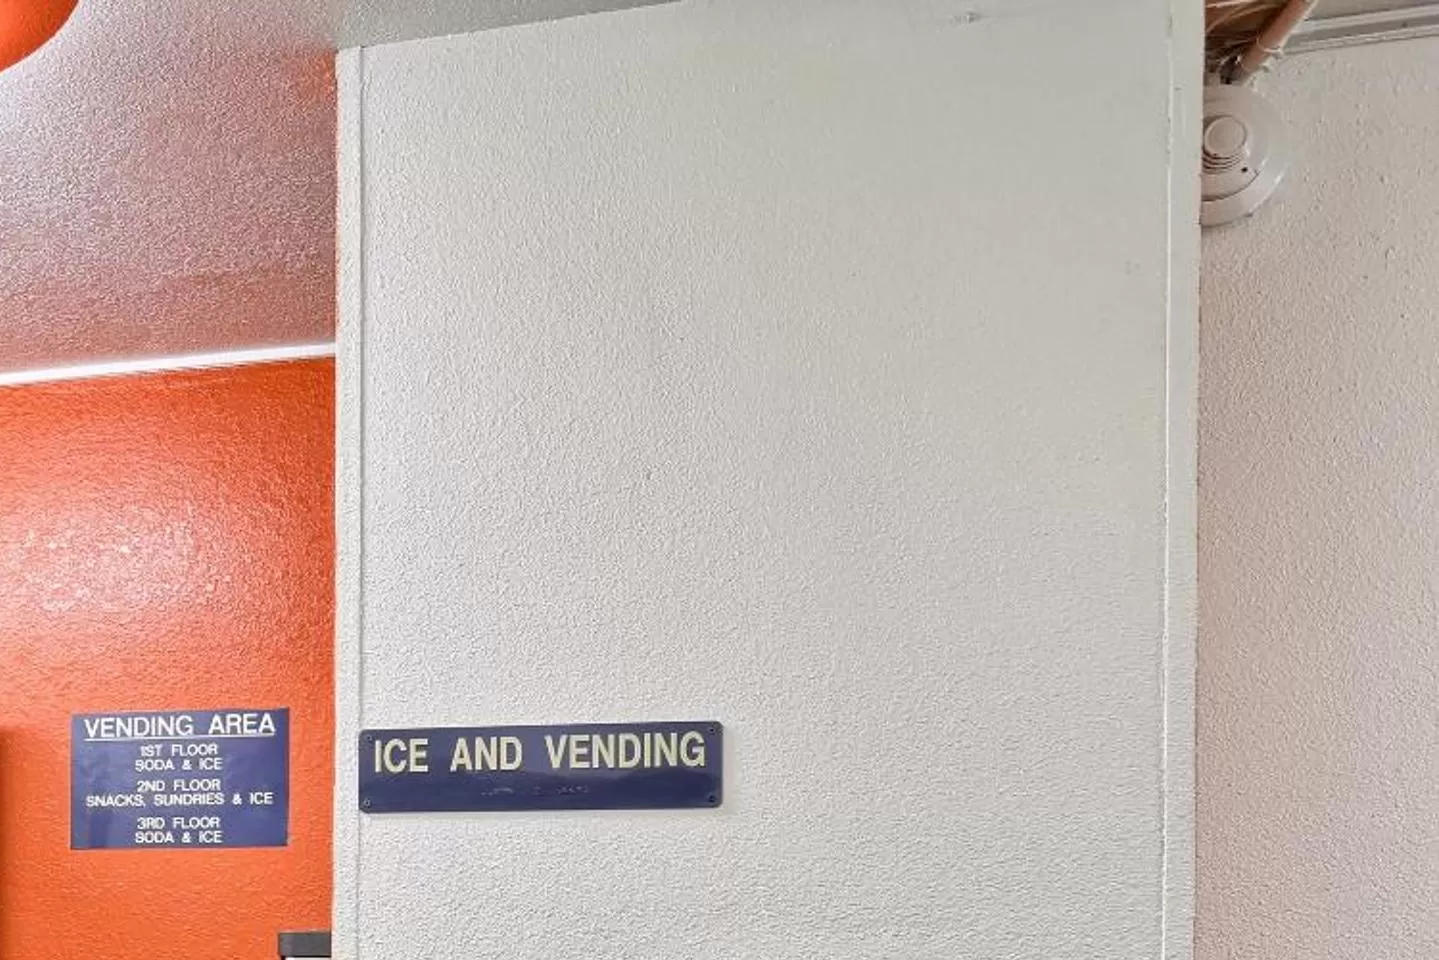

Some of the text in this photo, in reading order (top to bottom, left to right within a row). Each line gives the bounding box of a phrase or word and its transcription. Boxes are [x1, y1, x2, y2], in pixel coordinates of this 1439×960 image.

[84, 713, 276, 739] VENDING AREA
[140, 743, 219, 757] 1ST FLOOR
[374, 731, 706, 774] ICE AND VENDING
[135, 758, 223, 772] SODA & ICE
[136, 779, 221, 792] 2ND FLOOR
[153, 793, 225, 806] SUNDRIES
[231, 793, 243, 805] &
[250, 792, 274, 805] ICE
[136, 817, 221, 830] 3RD FLOOR
[135, 830, 223, 844] SODA & ICE
